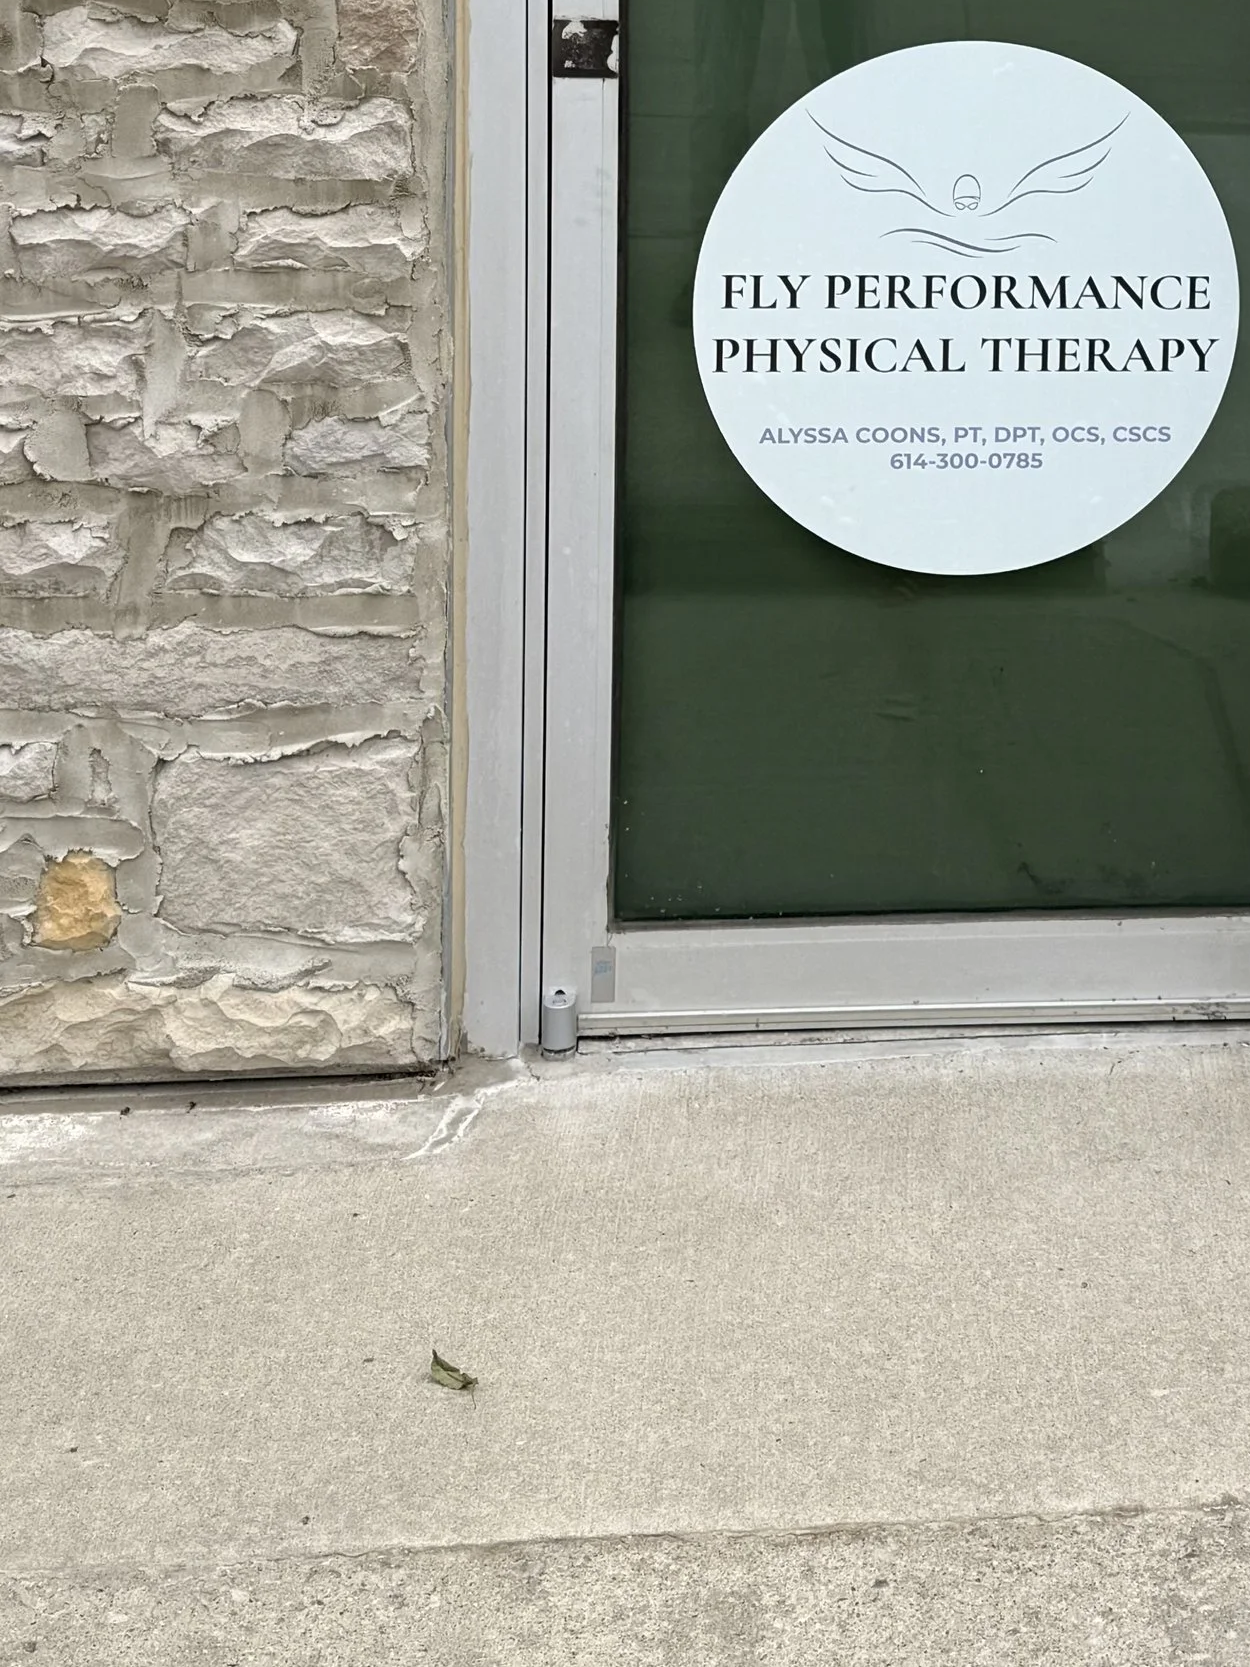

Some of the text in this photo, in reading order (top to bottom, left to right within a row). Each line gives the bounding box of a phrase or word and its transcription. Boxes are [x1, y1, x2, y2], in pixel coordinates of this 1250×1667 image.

[721, 274, 1211, 311] FLY PERFORMANCE
[712, 338, 1220, 374] PHYSICAL THERAPY
[759, 427, 1172, 447] ALYSSA COONS, PT, DPT, OCS, CSCS
[890, 453, 1044, 471] 614-300-0785
